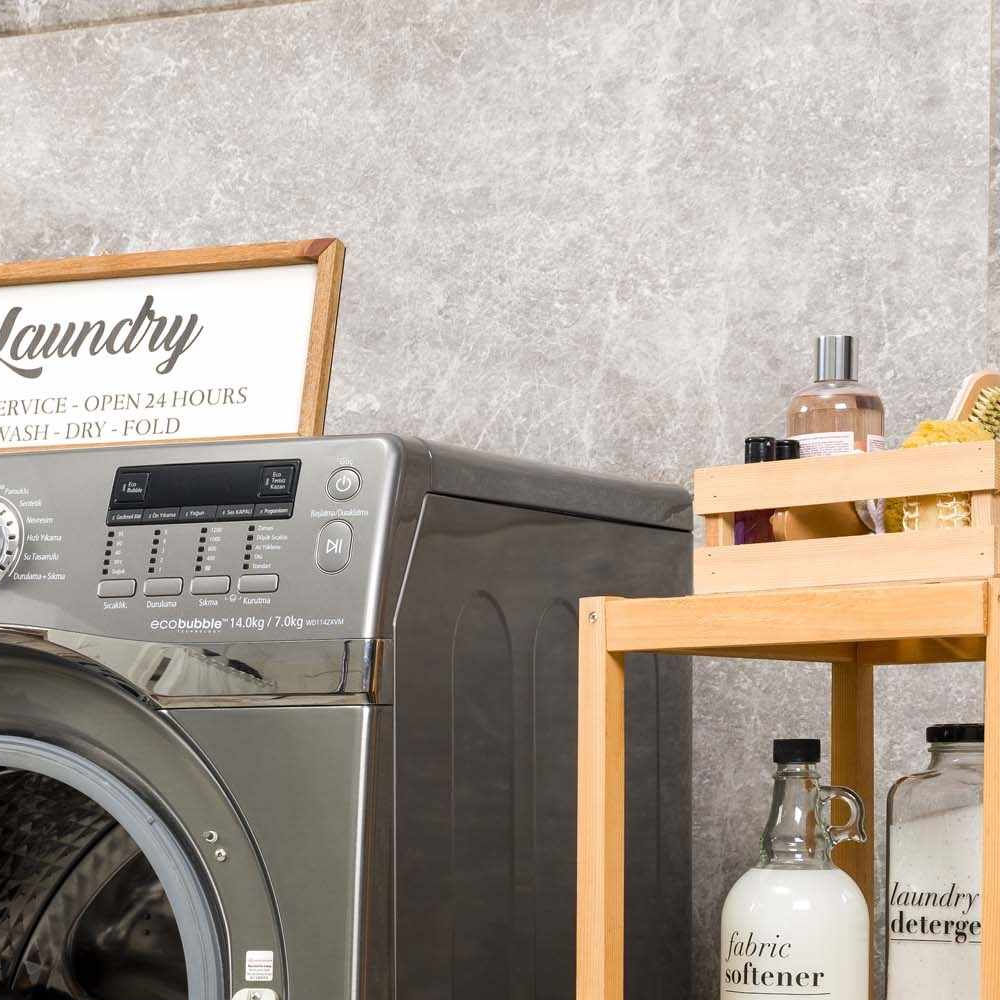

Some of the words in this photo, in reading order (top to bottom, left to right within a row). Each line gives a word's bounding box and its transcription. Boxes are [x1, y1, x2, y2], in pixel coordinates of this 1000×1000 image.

[84, 393, 142, 413] OPEN
[146, 392, 166, 409] 24
[172, 386, 248, 407] HOURS
[65, 420, 107, 440] DRY
[123, 417, 181, 436] FOLD
[230, 616, 265, 631] 14.0kg
[275, 615, 304, 630] 7.0kg
[890, 881, 980, 915] laundry
[890, 910, 982, 944] deterge
[725, 930, 792, 962] fabric
[725, 961, 825, 987] softener
